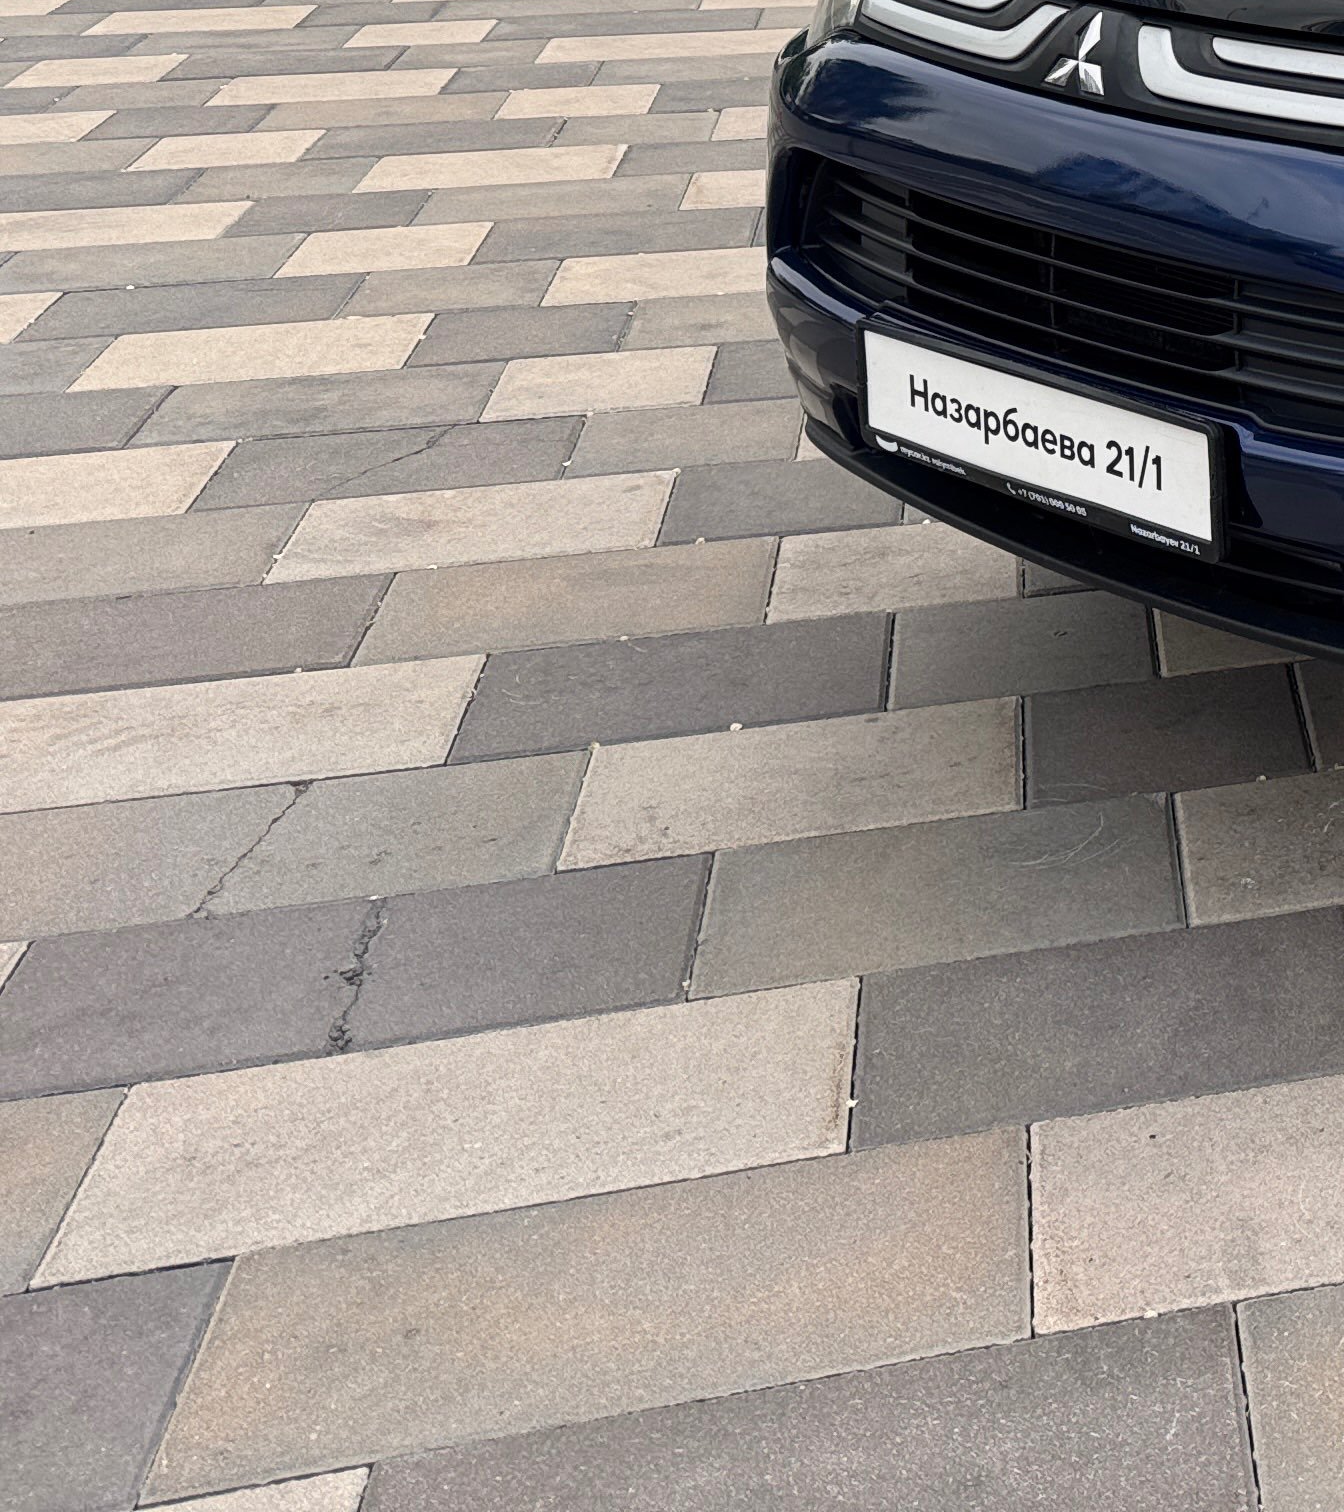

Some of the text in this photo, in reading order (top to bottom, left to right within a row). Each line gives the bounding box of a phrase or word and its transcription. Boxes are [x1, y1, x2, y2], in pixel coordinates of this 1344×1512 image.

[909, 374, 1163, 491] Назарбаева 21/1
[1180, 540, 1201, 555] 21/1
